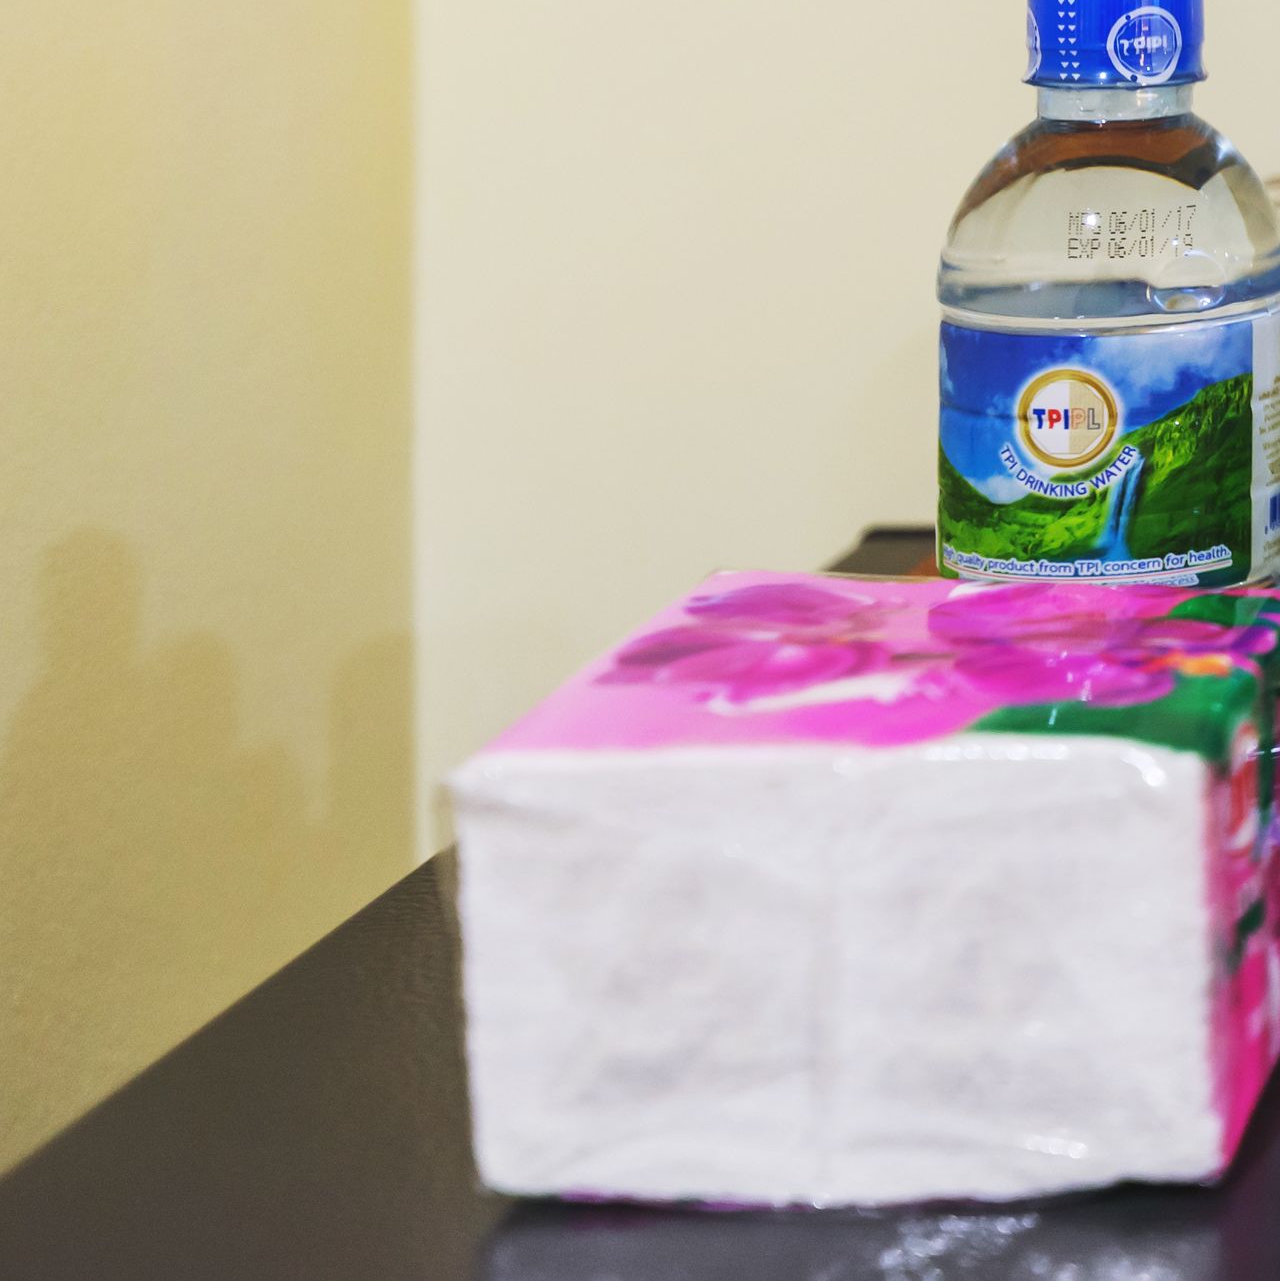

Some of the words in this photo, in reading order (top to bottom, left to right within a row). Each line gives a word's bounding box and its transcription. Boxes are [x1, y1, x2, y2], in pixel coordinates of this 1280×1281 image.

[1068, 238, 1101, 259] EXP
[1032, 408, 1101, 430] TPIPL
[1000, 445, 1018, 470] TPI
[1016, 468, 1088, 497] DRINKING
[1090, 445, 1137, 489] WATER
[988, 558, 1035, 573] product
[1039, 561, 1072, 574] from
[1077, 562, 1099, 574] TPI
[1104, 558, 1161, 572] concern
[1166, 554, 1185, 567] for
[1189, 546, 1230, 564] health.
